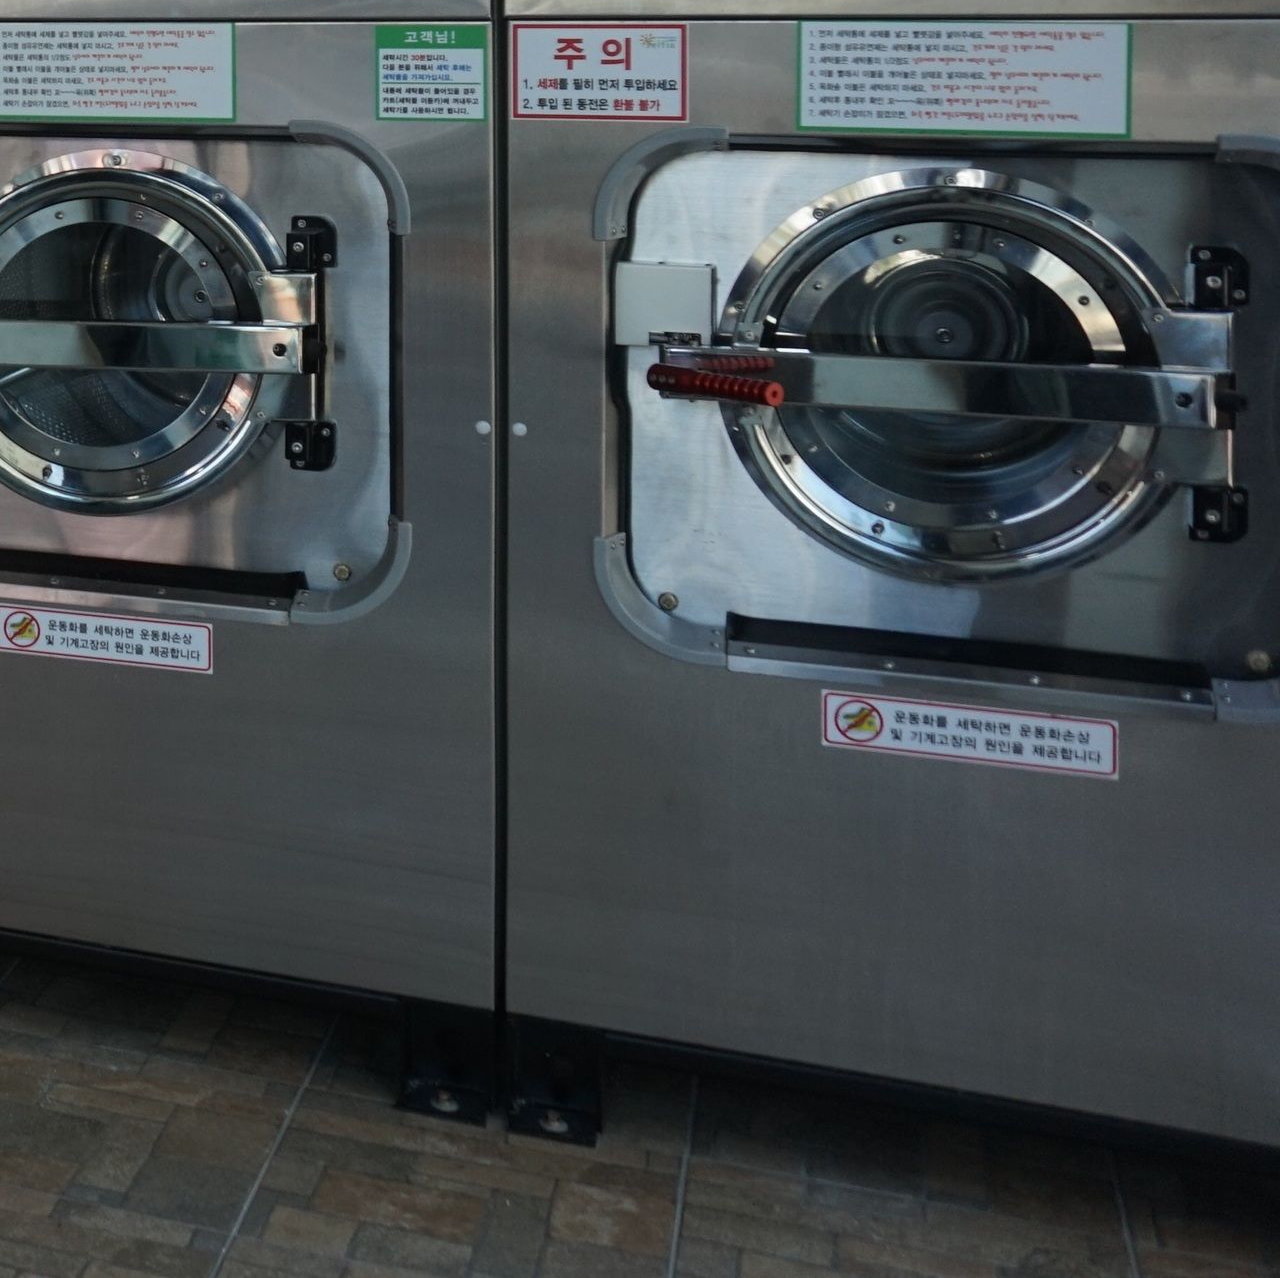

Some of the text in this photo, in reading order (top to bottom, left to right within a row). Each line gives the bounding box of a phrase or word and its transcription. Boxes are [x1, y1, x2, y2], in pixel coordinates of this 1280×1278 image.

[404, 30, 455, 44] 고객님!
[523, 79, 678, 91] 1. 세제를 필히 먼저 투입하세요
[523, 99, 532, 109] 2.
[538, 98, 558, 110] 투입
[563, 99, 572, 110] 된
[577, 99, 608, 110] 동전은
[48, 620, 192, 644] 운동화를 세탁하면 운동화손상
[61, 637, 109, 651] 기계고장의
[116, 643, 143, 655] 원인을
[150, 647, 200, 661] 제공합니다
